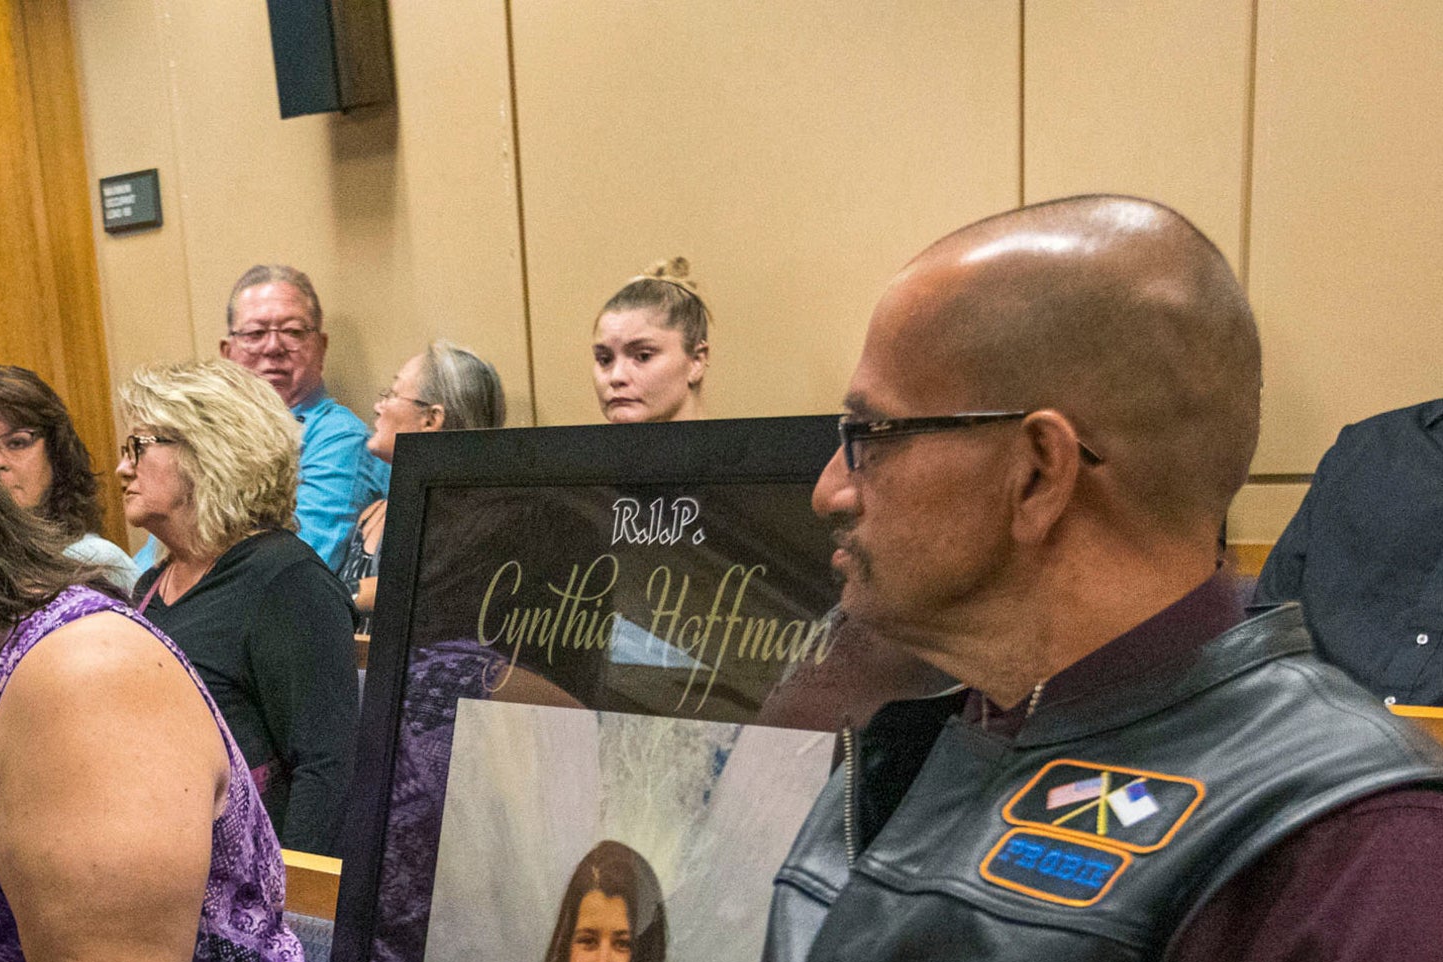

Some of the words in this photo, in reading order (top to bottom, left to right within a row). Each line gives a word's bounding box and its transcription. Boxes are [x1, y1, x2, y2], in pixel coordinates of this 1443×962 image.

[611, 497, 706, 546] R.I.P.
[477, 554, 621, 693] Cynthia
[646, 564, 835, 714] Hoffman
